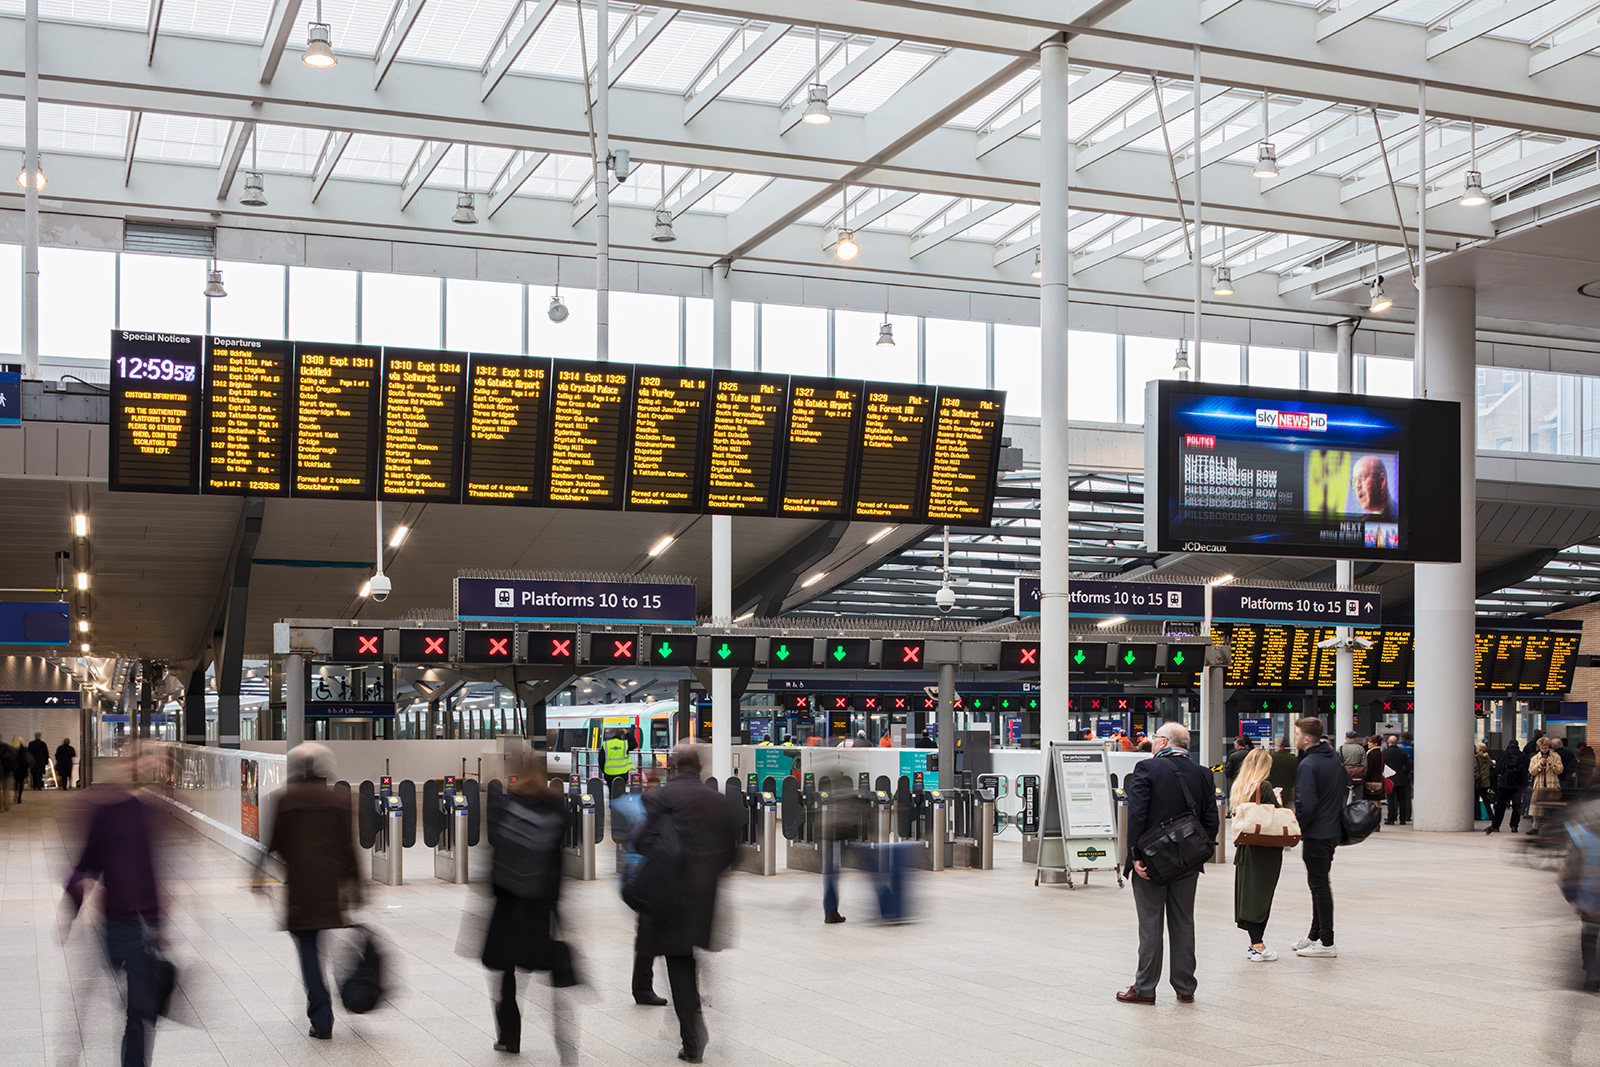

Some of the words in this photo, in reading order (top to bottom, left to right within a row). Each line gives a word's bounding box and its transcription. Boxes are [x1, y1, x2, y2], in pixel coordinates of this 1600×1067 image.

[122, 332, 155, 342] Special
[157, 334, 191, 344] Notices
[213, 337, 261, 348] Departures
[302, 354, 324, 365] 13:08
[329, 356, 349, 368] Expt
[352, 358, 374, 368] 13:11
[390, 360, 412, 370] 13:10
[417, 362, 436, 373] Expt
[439, 363, 461, 373] 13:14
[300, 366, 332, 377] Uckfield
[389, 371, 401, 381] via
[403, 372, 437, 383] Selhurst
[476, 366, 497, 376] 13:12
[502, 368, 521, 378] Expt
[523, 369, 545, 379] 13:15
[559, 371, 580, 381] 13:14
[584, 373, 603, 383] Expt
[474, 377, 486, 386] via
[487, 378, 514, 388] Gatwick
[514, 379, 541, 390] Airport
[557, 382, 569, 391] via
[570, 383, 596, 394] Crystal
[597, 385, 619, 395] Palace
[638, 388, 650, 396] via
[651, 388, 675, 399] Purley
[716, 393, 728, 401] via
[730, 393, 749, 403] Tulse
[750, 395, 761, 404] Hill
[793, 398, 804, 407] via
[804, 399, 829, 409] Gatwick
[829, 400, 853, 411] Airport
[867, 404, 878, 412] via
[879, 404, 903, 414] Forest
[904, 406, 915, 414] Hill
[940, 408, 950, 417] via
[951, 409, 979, 419] Selhurst
[1258, 412, 1277, 425] sky
[1278, 414, 1308, 427] NEWS
[1310, 417, 1325, 426] HD
[1182, 542, 1227, 552] JCDecaux
[521, 591, 594, 607] Platforms
[599, 593, 618, 608] 10
[622, 595, 638, 608] to
[642, 595, 661, 608] 15
[1114, 592, 1128, 604] 10
[1132, 593, 1144, 605] to
[1148, 593, 1162, 605] 15
[1241, 596, 1294, 611] Platforms
[1296, 599, 1310, 612] 10
[1313, 601, 1325, 612] to
[1328, 601, 1341, 613] 15
